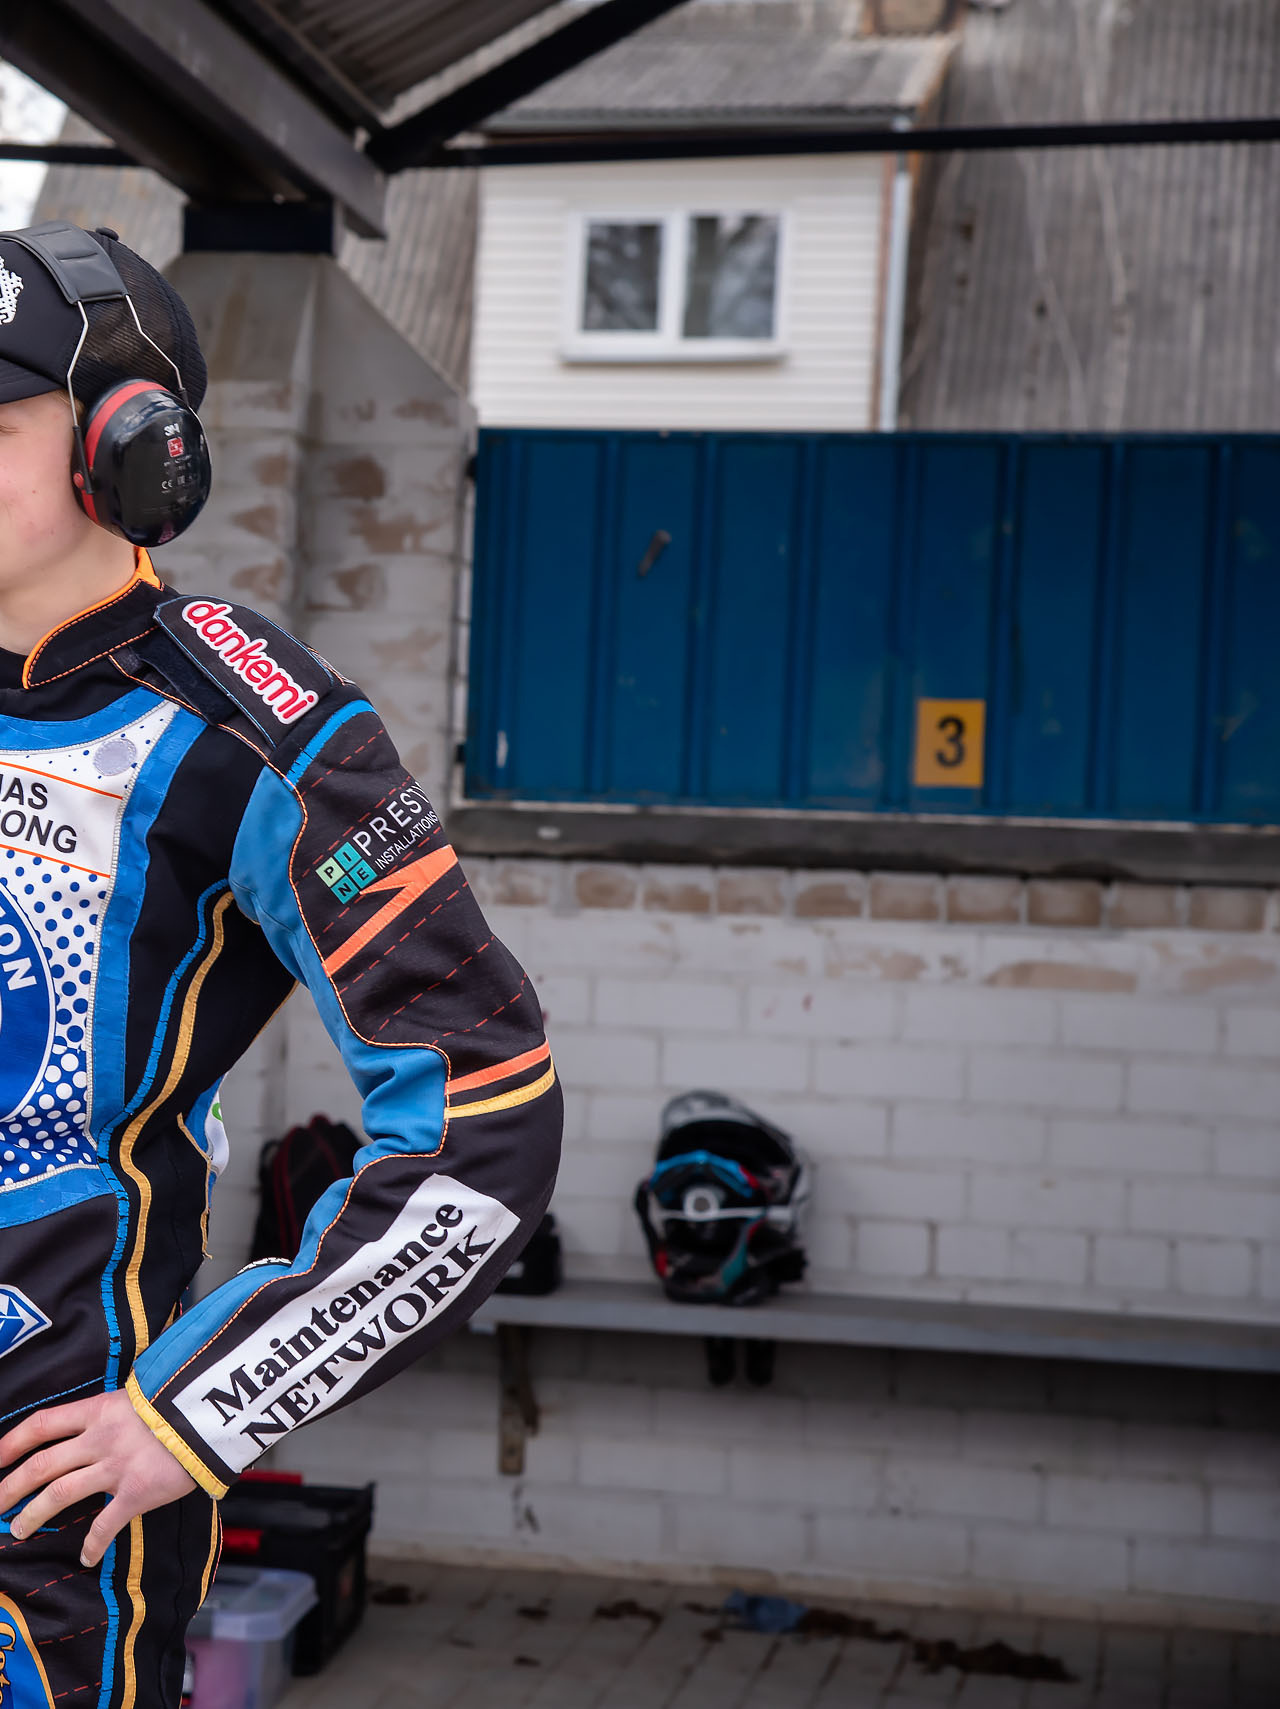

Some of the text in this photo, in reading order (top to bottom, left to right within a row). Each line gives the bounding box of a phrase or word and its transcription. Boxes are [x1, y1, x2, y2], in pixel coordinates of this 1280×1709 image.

[186, 602, 316, 720] dankemi
[936, 715, 965, 769] 3
[375, 810, 438, 870] INSTALLATIONS
[200, 1203, 464, 1427] Maintenance
[240, 1225, 497, 1454] NETWORK
